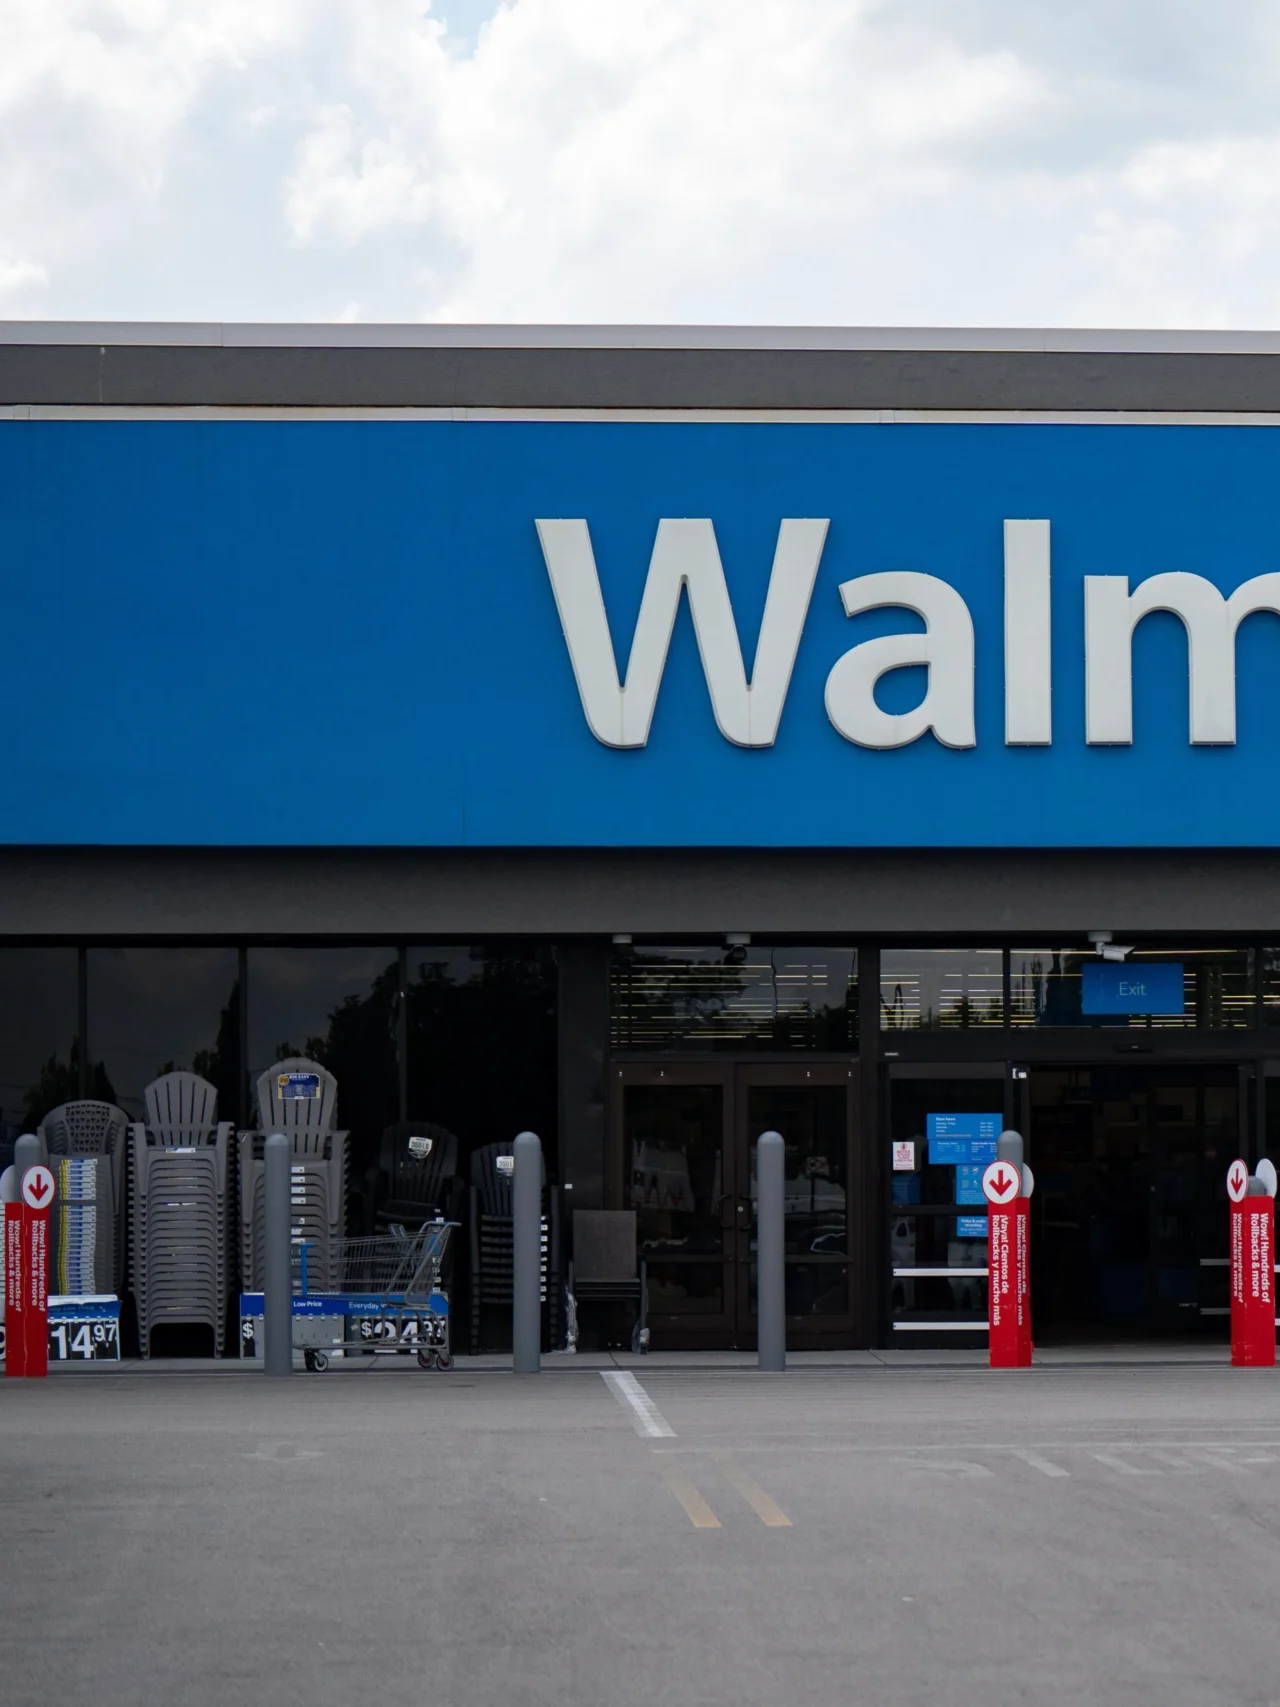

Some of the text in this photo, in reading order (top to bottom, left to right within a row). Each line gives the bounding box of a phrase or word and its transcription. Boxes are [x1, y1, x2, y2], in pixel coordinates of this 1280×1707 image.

[1119, 982, 1147, 996] Exit
[31, 1219, 39, 1268] Rollbacks
[1251, 1213, 1260, 1261] Rollbacks
[38, 1219, 47, 1312] Wow! Hundreds of
[1001, 1243, 1009, 1280] Cientos
[1261, 1213, 1270, 1303] Wow! Hundreds of
[9, 1269, 15, 1277] &
[14, 1249, 22, 1299] Hundreds
[32, 1269, 39, 1277] &
[1252, 1270, 1260, 1297] more
[993, 1270, 1001, 1304] mucho
[1002, 1281, 1009, 1294] de
[15, 1301, 22, 1312] of
[293, 1300, 322, 1308] Low Price
[348, 1301, 379, 1310] Everyday
